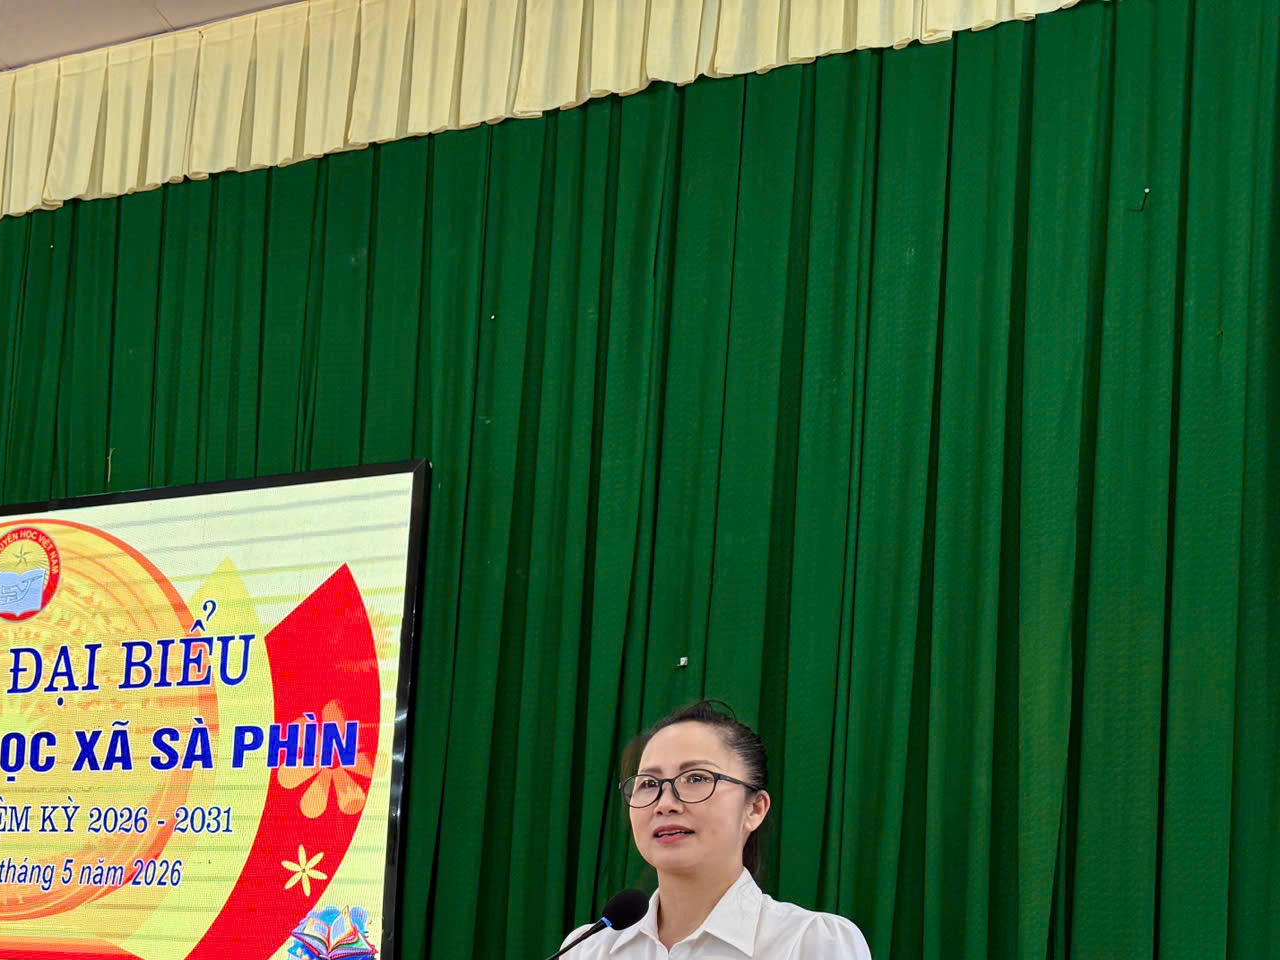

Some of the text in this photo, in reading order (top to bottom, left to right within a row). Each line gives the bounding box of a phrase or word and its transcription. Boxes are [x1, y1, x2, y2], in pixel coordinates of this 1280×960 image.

[6, 643, 103, 706] ĐẠI
[118, 599, 256, 690] BIỂU
[71, 720, 134, 771] XÃ
[150, 717, 214, 770] SÀ
[231, 713, 358, 769] PHÌN
[38, 795, 81, 833] KỲ
[87, 806, 148, 834] 2026
[173, 806, 233, 834] 2031
[61, 858, 74, 885] 5
[78, 859, 125, 886] năm
[131, 859, 183, 887] 2026
